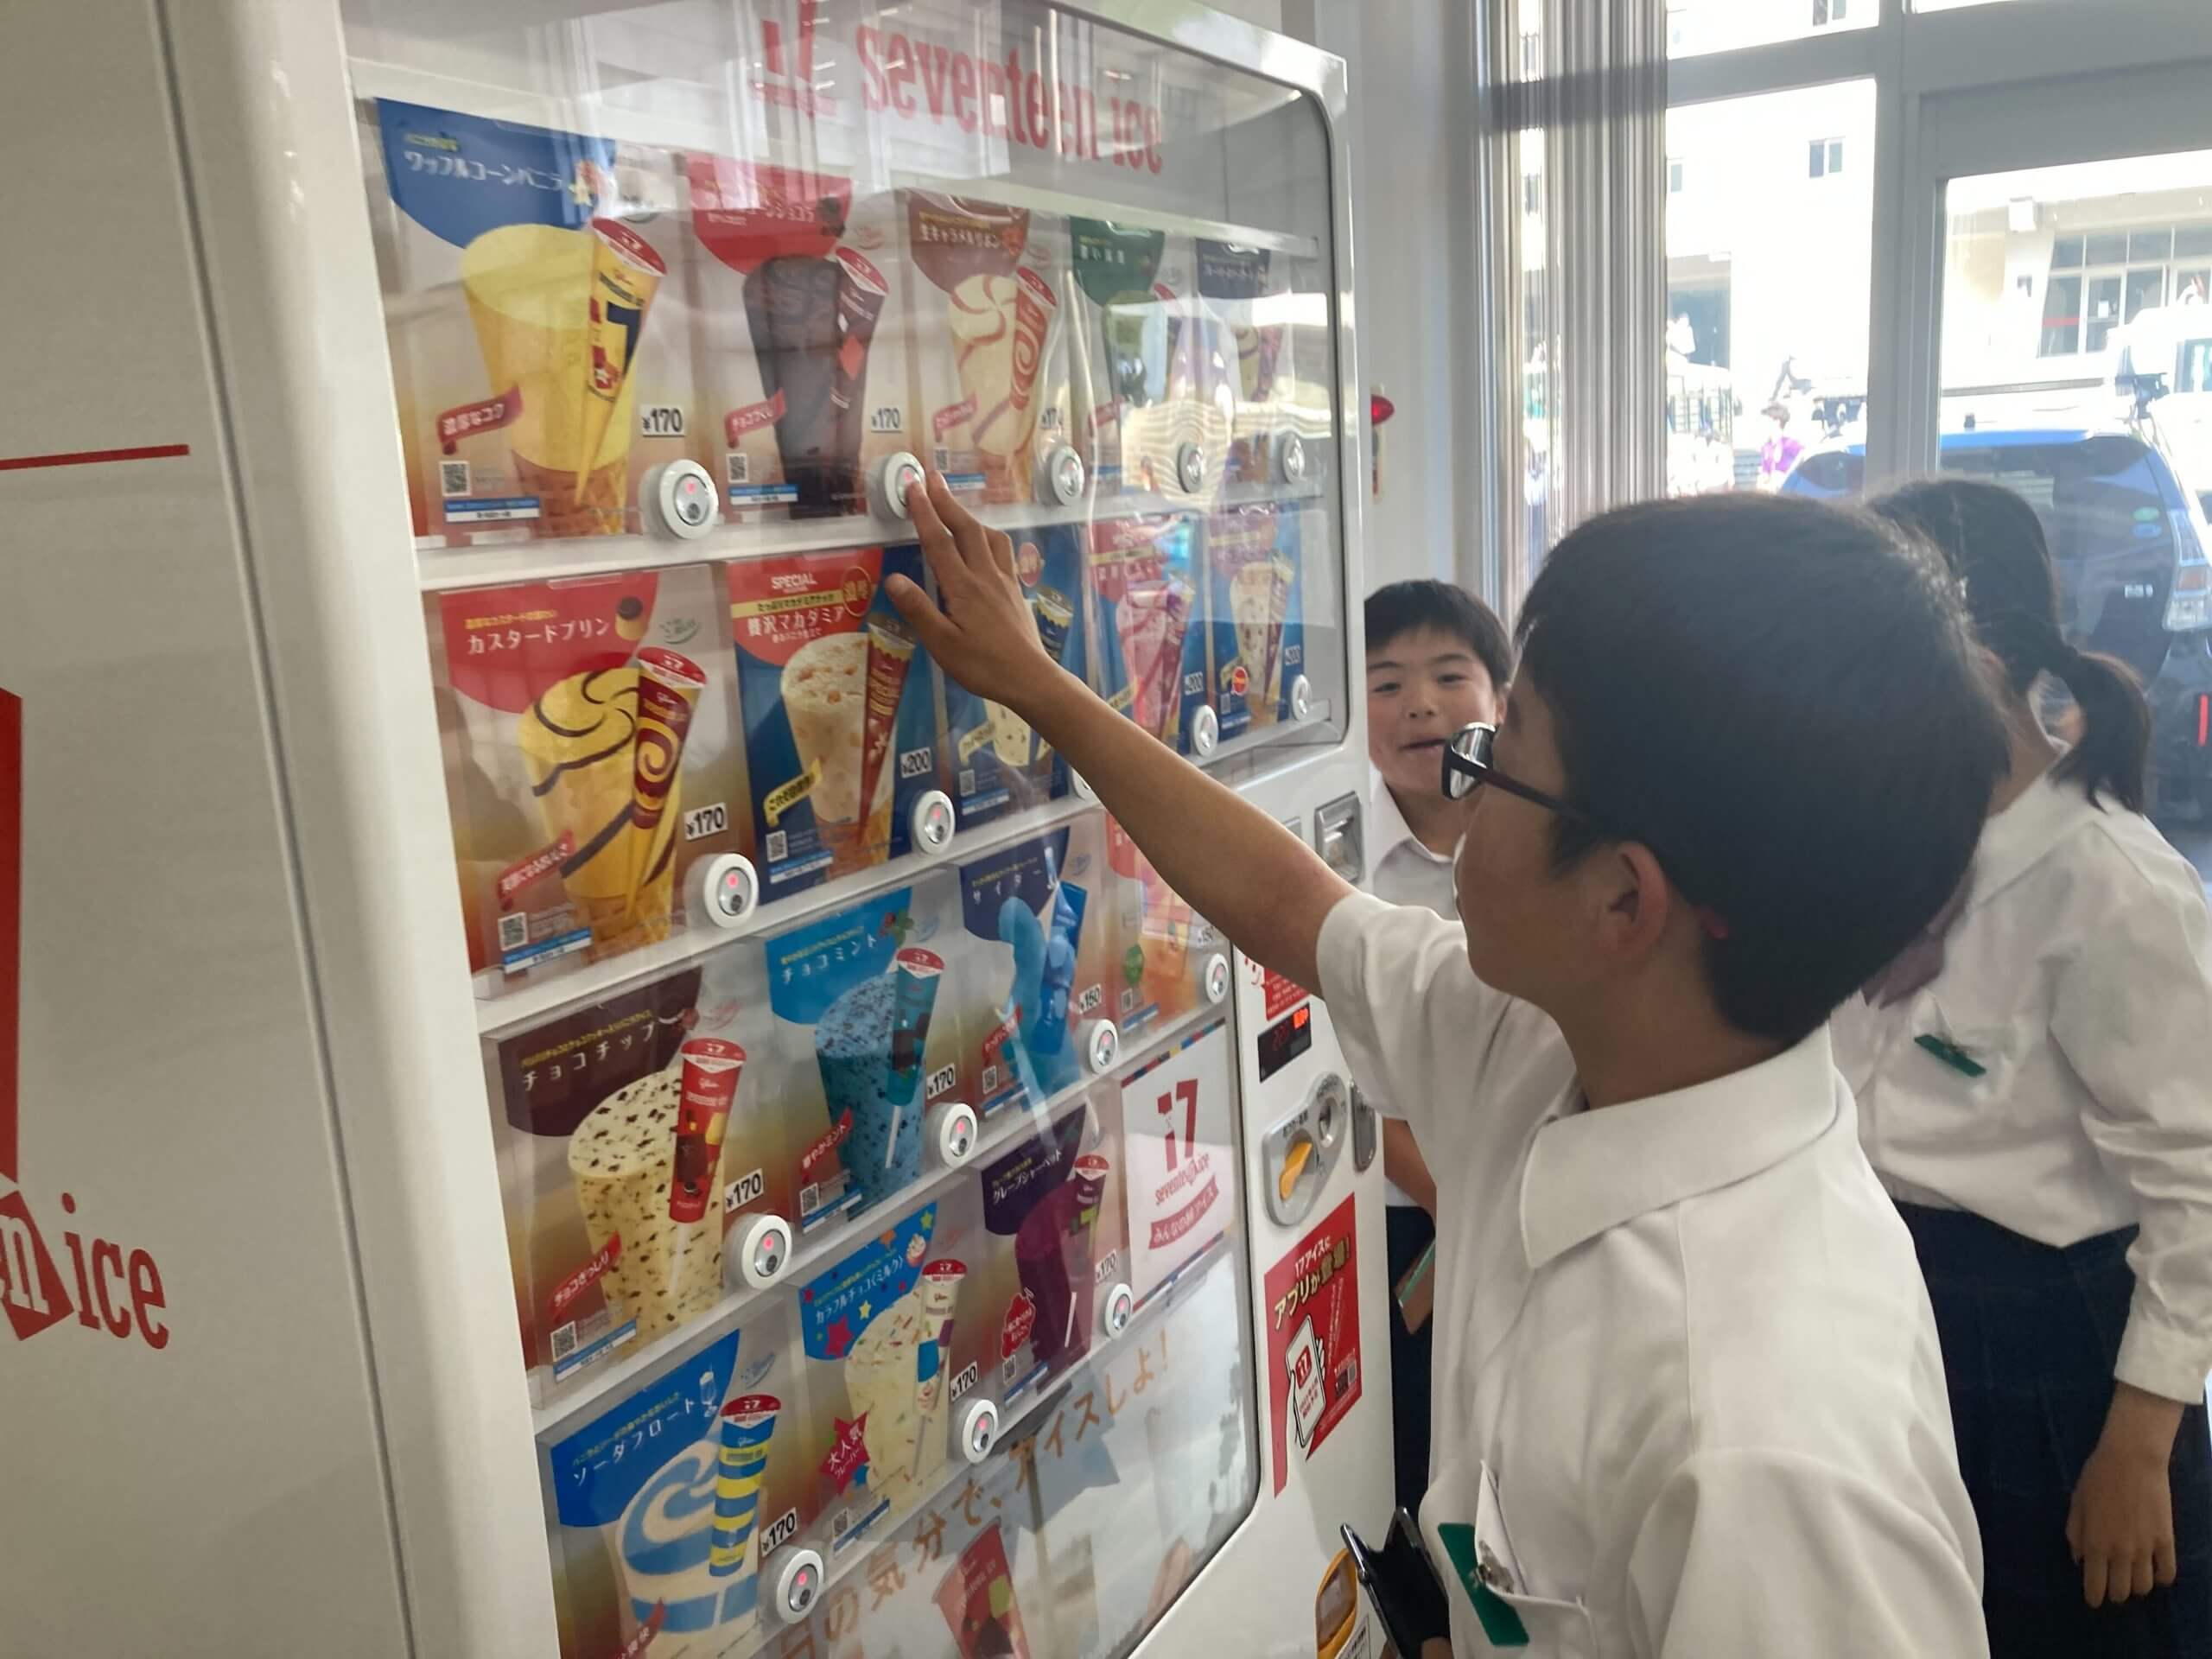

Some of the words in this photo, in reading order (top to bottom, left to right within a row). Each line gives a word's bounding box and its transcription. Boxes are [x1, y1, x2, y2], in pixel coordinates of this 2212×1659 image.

[855, 24, 1099, 161] seventeen
[1112, 92, 1162, 174] ice
[403, 149, 563, 191] ワッフルコーンバニラ
[642, 408, 683, 432] ¥170
[771, 573, 817, 590] SPECIAL
[467, 618, 609, 655] カスタードプリン
[685, 806, 725, 835] ¥170
[781, 933, 877, 985] チョコミント
[522, 1021, 655, 1091] チョコチップ
[927, 1067, 955, 1096] ¥170
[726, 1173, 762, 1208] ¥170
[61, 1192, 168, 1350] ice
[951, 1365, 977, 1397] ¥170
[573, 1396, 694, 1487] ソーダフロート
[761, 1513, 796, 1554] ¥170
